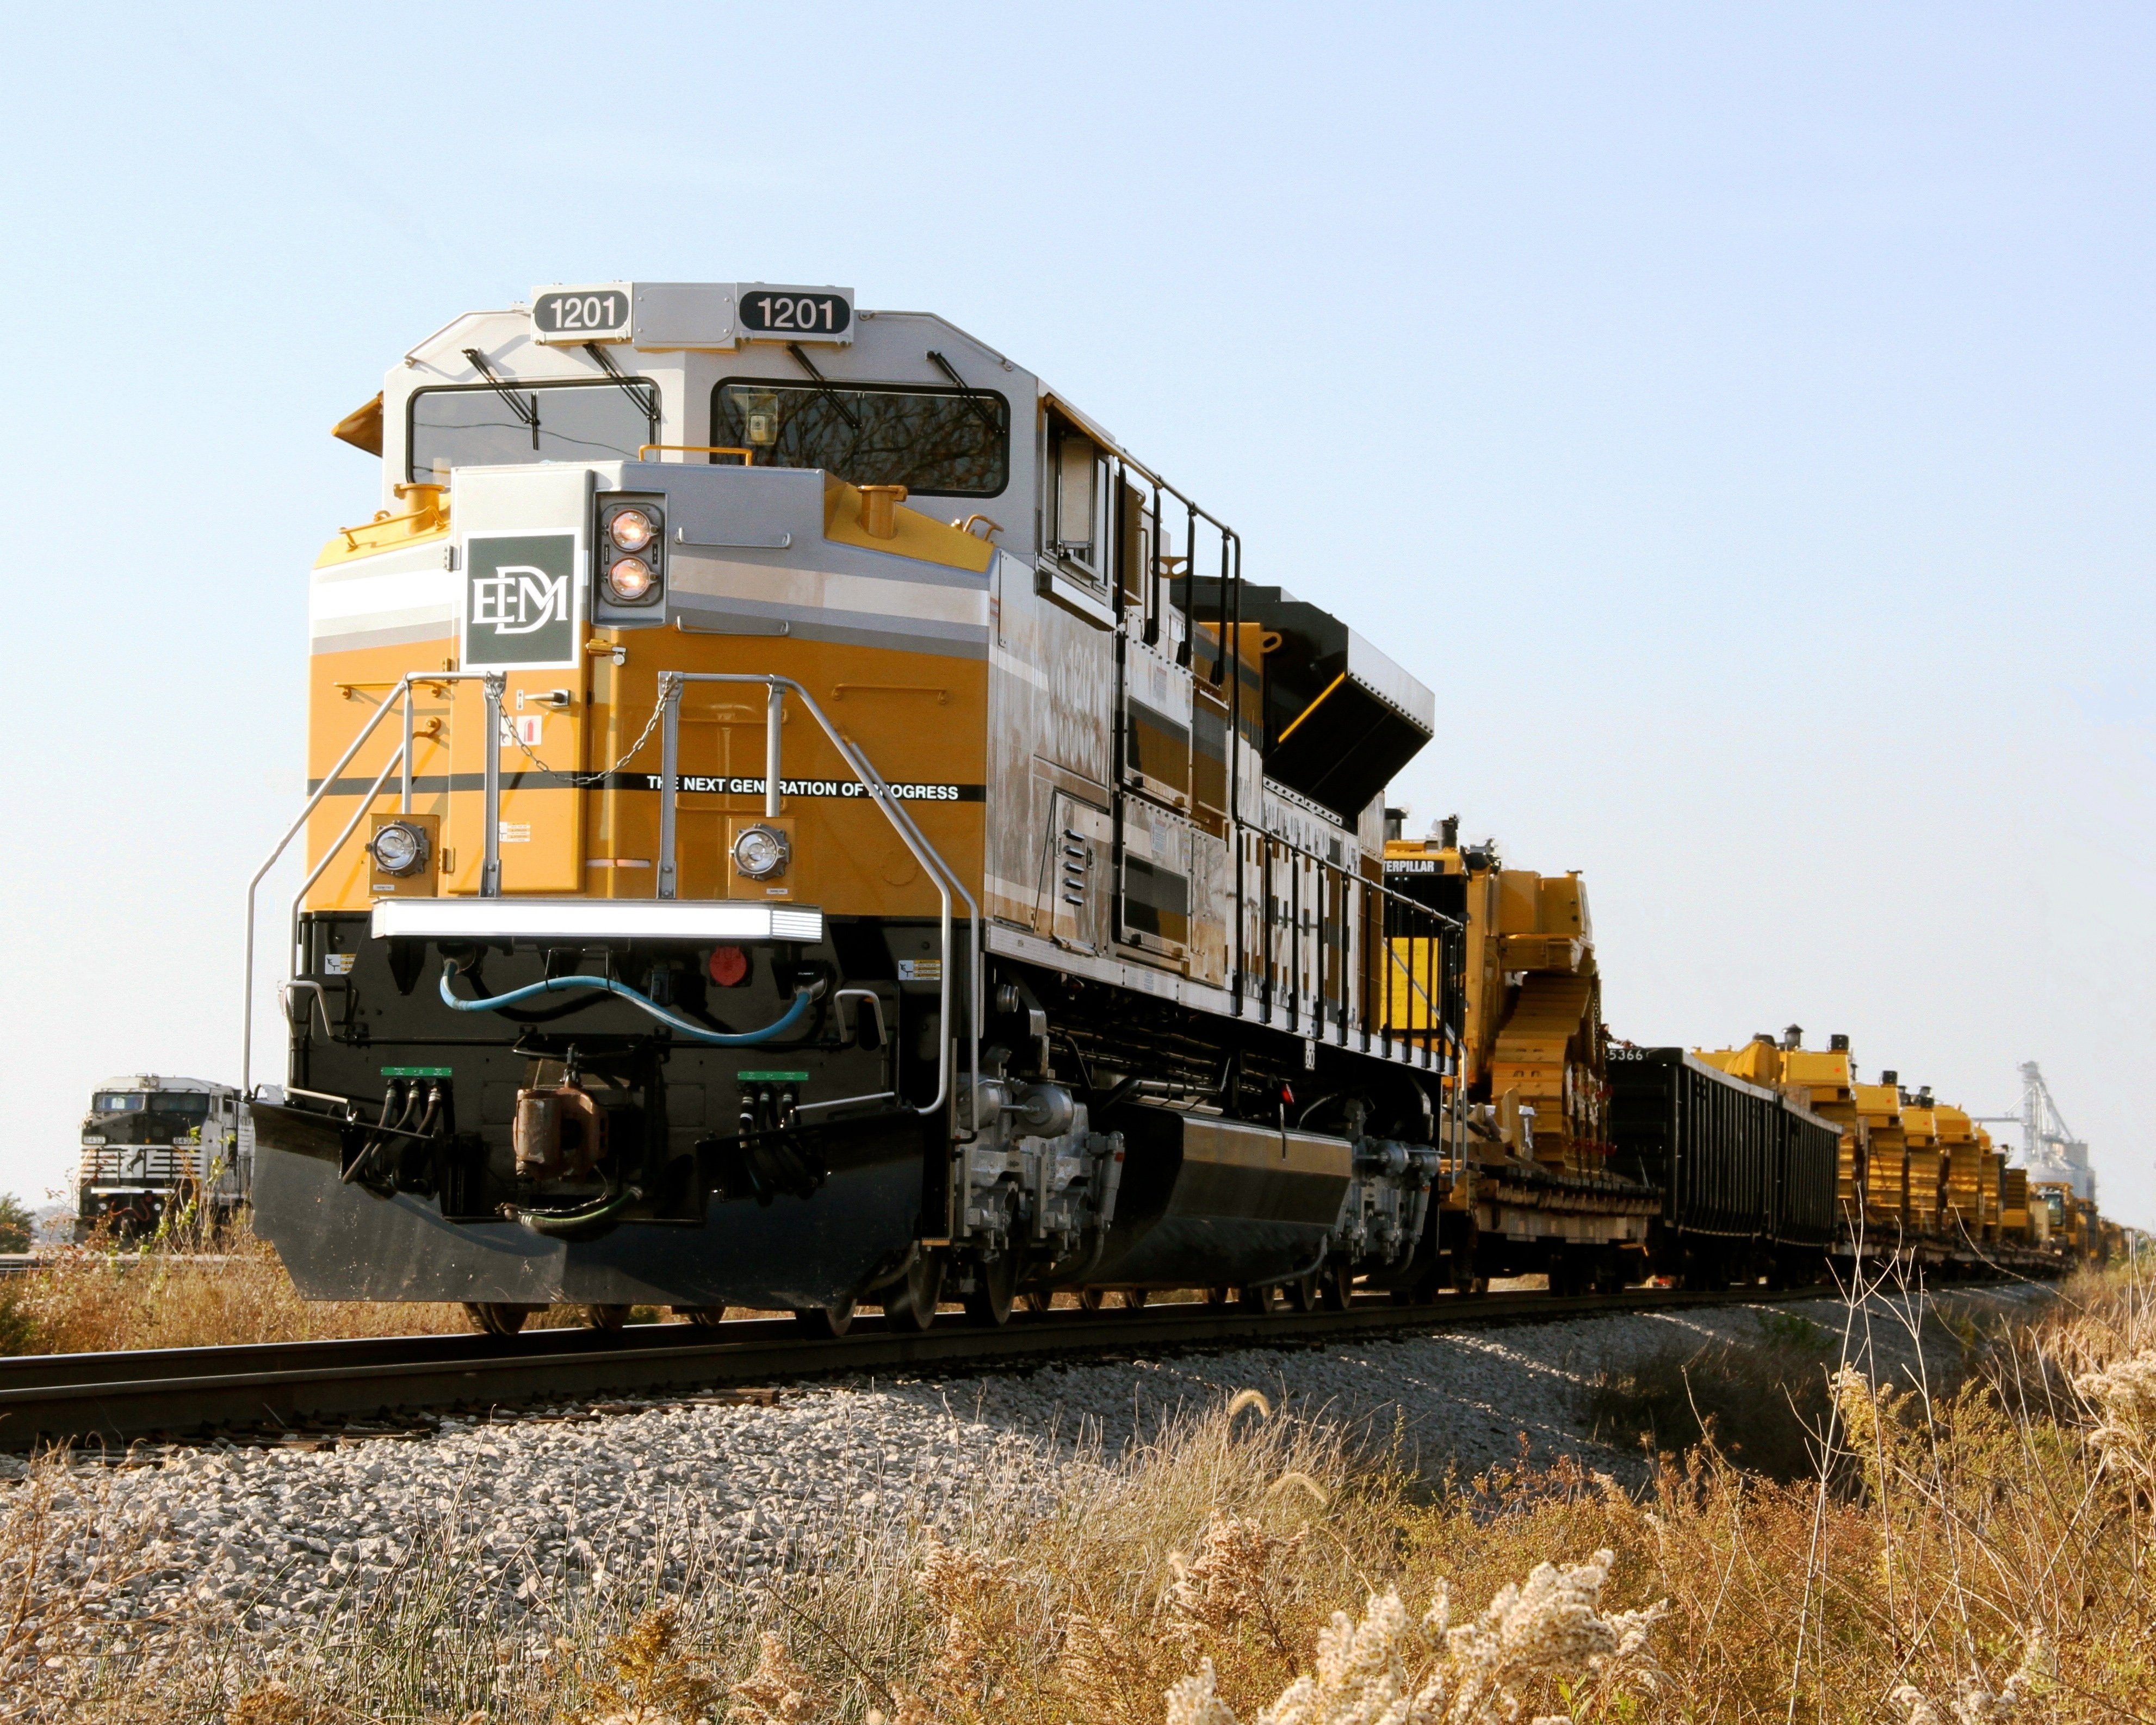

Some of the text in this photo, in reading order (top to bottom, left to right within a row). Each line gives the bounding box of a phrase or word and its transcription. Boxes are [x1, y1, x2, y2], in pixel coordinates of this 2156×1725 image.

[550, 296, 615, 329] 1201
[757, 297, 833, 330] 1201
[684, 776, 726, 792] NEXT
[729, 778, 837, 796] GENRATION
[841, 782, 865, 797] OF
[1605, 1049, 1643, 1060] 5366
